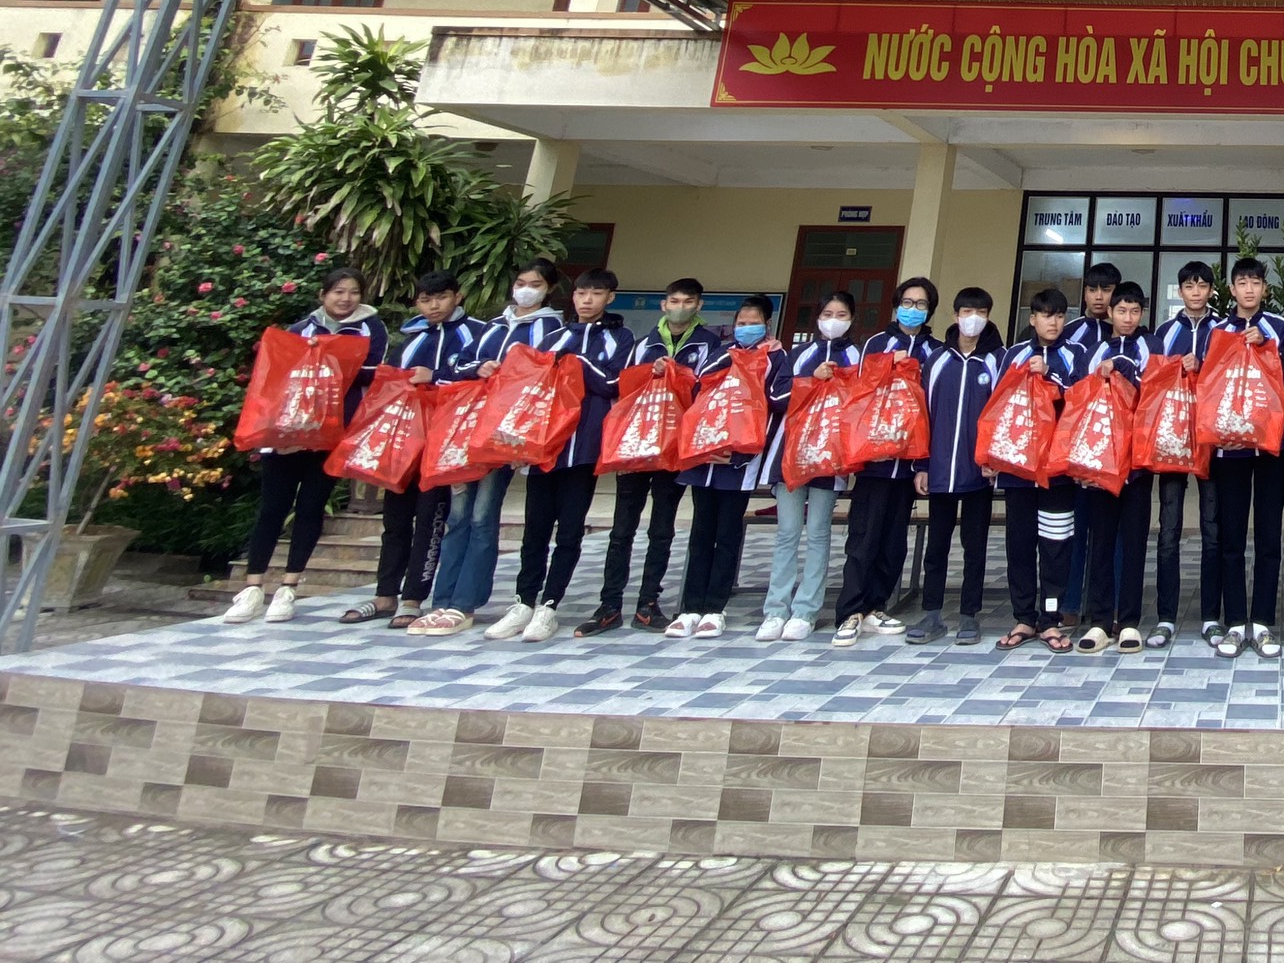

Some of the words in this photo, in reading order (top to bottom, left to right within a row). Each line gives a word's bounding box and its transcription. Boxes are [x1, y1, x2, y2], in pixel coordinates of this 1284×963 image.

[863, 23, 952, 82] NƯỚC
[960, 25, 1046, 93] CỘNG
[1055, 25, 1117, 85] HÒA
[1126, 29, 1168, 85] XÃ
[1178, 29, 1229, 96] HỘI
[1034, 213, 1061, 226] TRUNG
[1126, 213, 1141, 228] TẠO
